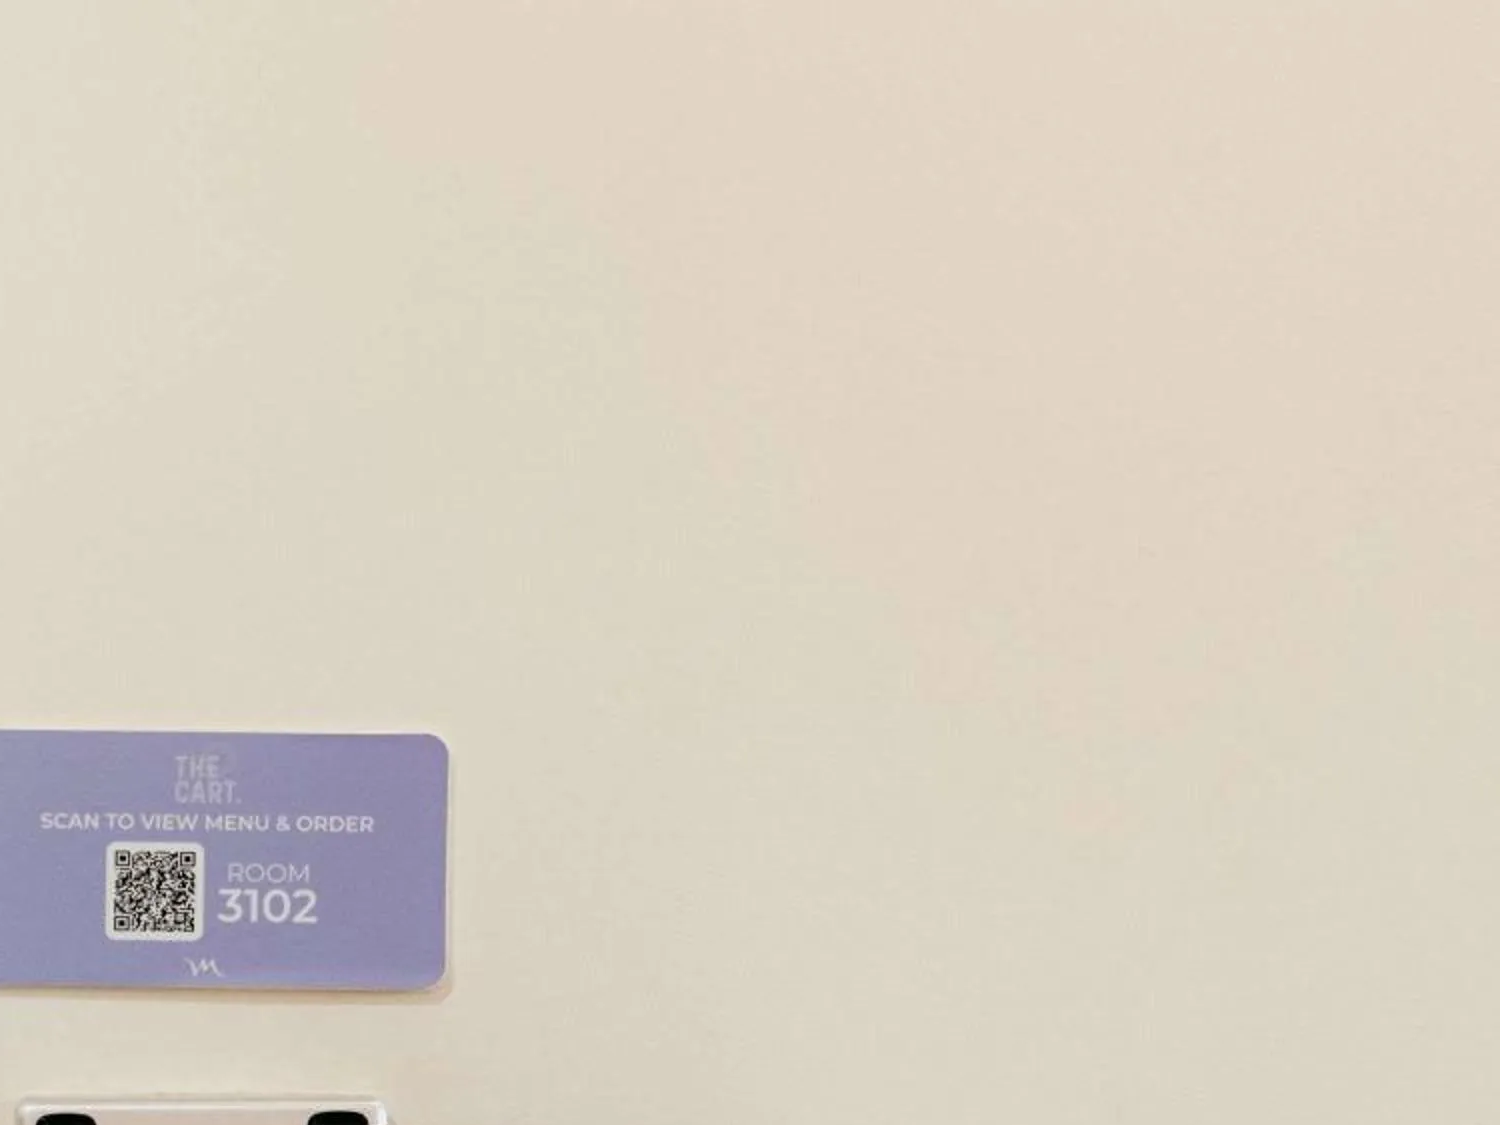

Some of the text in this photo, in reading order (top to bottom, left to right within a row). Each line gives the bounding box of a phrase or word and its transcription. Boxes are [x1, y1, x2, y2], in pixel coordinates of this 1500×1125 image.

[175, 754, 219, 780] THE
[40, 812, 375, 834] SCAN TO VIEW MENU & ORDER
[227, 863, 311, 884] ROOM
[217, 888, 319, 924] 3102
